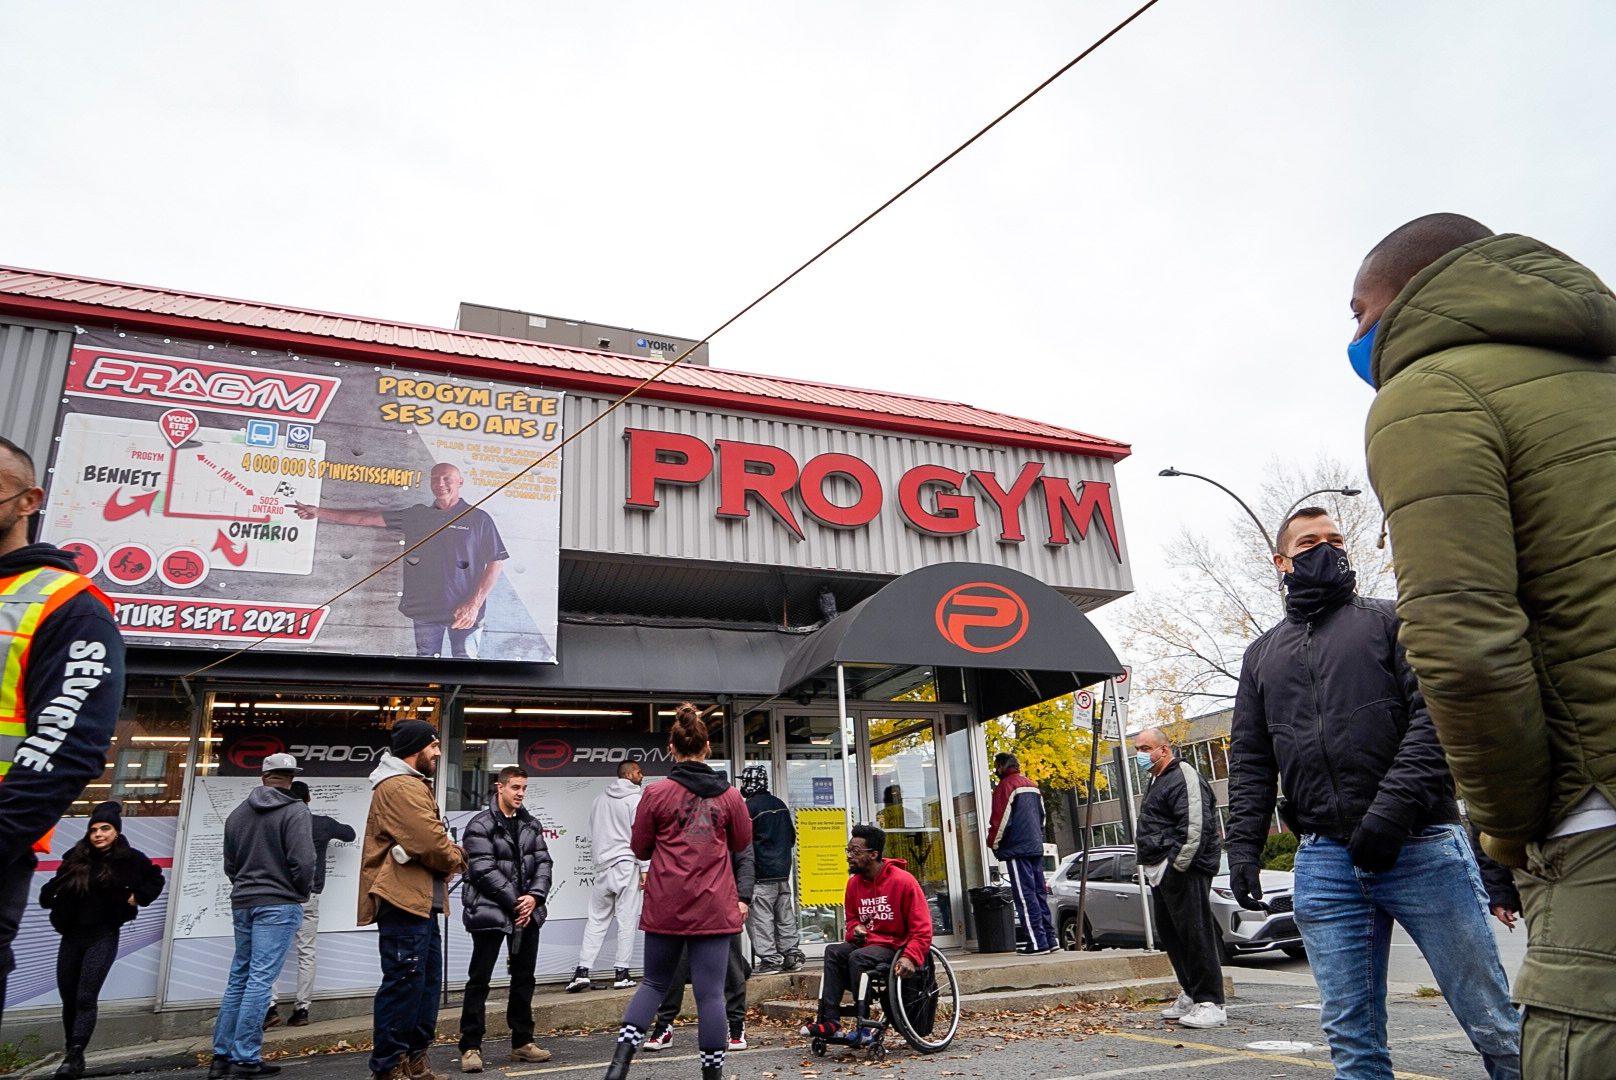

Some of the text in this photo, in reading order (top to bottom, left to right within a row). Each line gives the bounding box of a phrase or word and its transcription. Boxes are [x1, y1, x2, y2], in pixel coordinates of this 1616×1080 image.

[647, 339, 676, 352] YORK
[378, 376, 557, 416] PROGYM FÊTE
[167, 414, 193, 424] VOUS
[380, 403, 433, 425] SES
[438, 410, 479, 430] 40
[483, 416, 539, 438] ANS
[170, 429, 185, 437] ICI
[131, 450, 165, 462] PROGYM
[437, 440, 465, 450] PLUS
[466, 443, 481, 452] DE
[503, 447, 542, 459] PLACES
[83, 465, 161, 487] BENNETT
[241, 453, 252, 472] 4
[253, 454, 279, 475] 000
[281, 457, 306, 476] 000
[308, 458, 316, 478] $
[318, 460, 415, 488] D'INVESTISSEMENT
[537, 476, 557, 485] DES
[504, 489, 551, 502] COMMUN
[543, 485, 557, 494] EN
[260, 496, 279, 506] 5025
[252, 504, 285, 515] ONTARIO
[229, 522, 299, 542] ONTARIO
[180, 604, 237, 632] SEPT.
[241, 609, 295, 634] 2021
[13, 640, 112, 772] SÉCURITÉ
